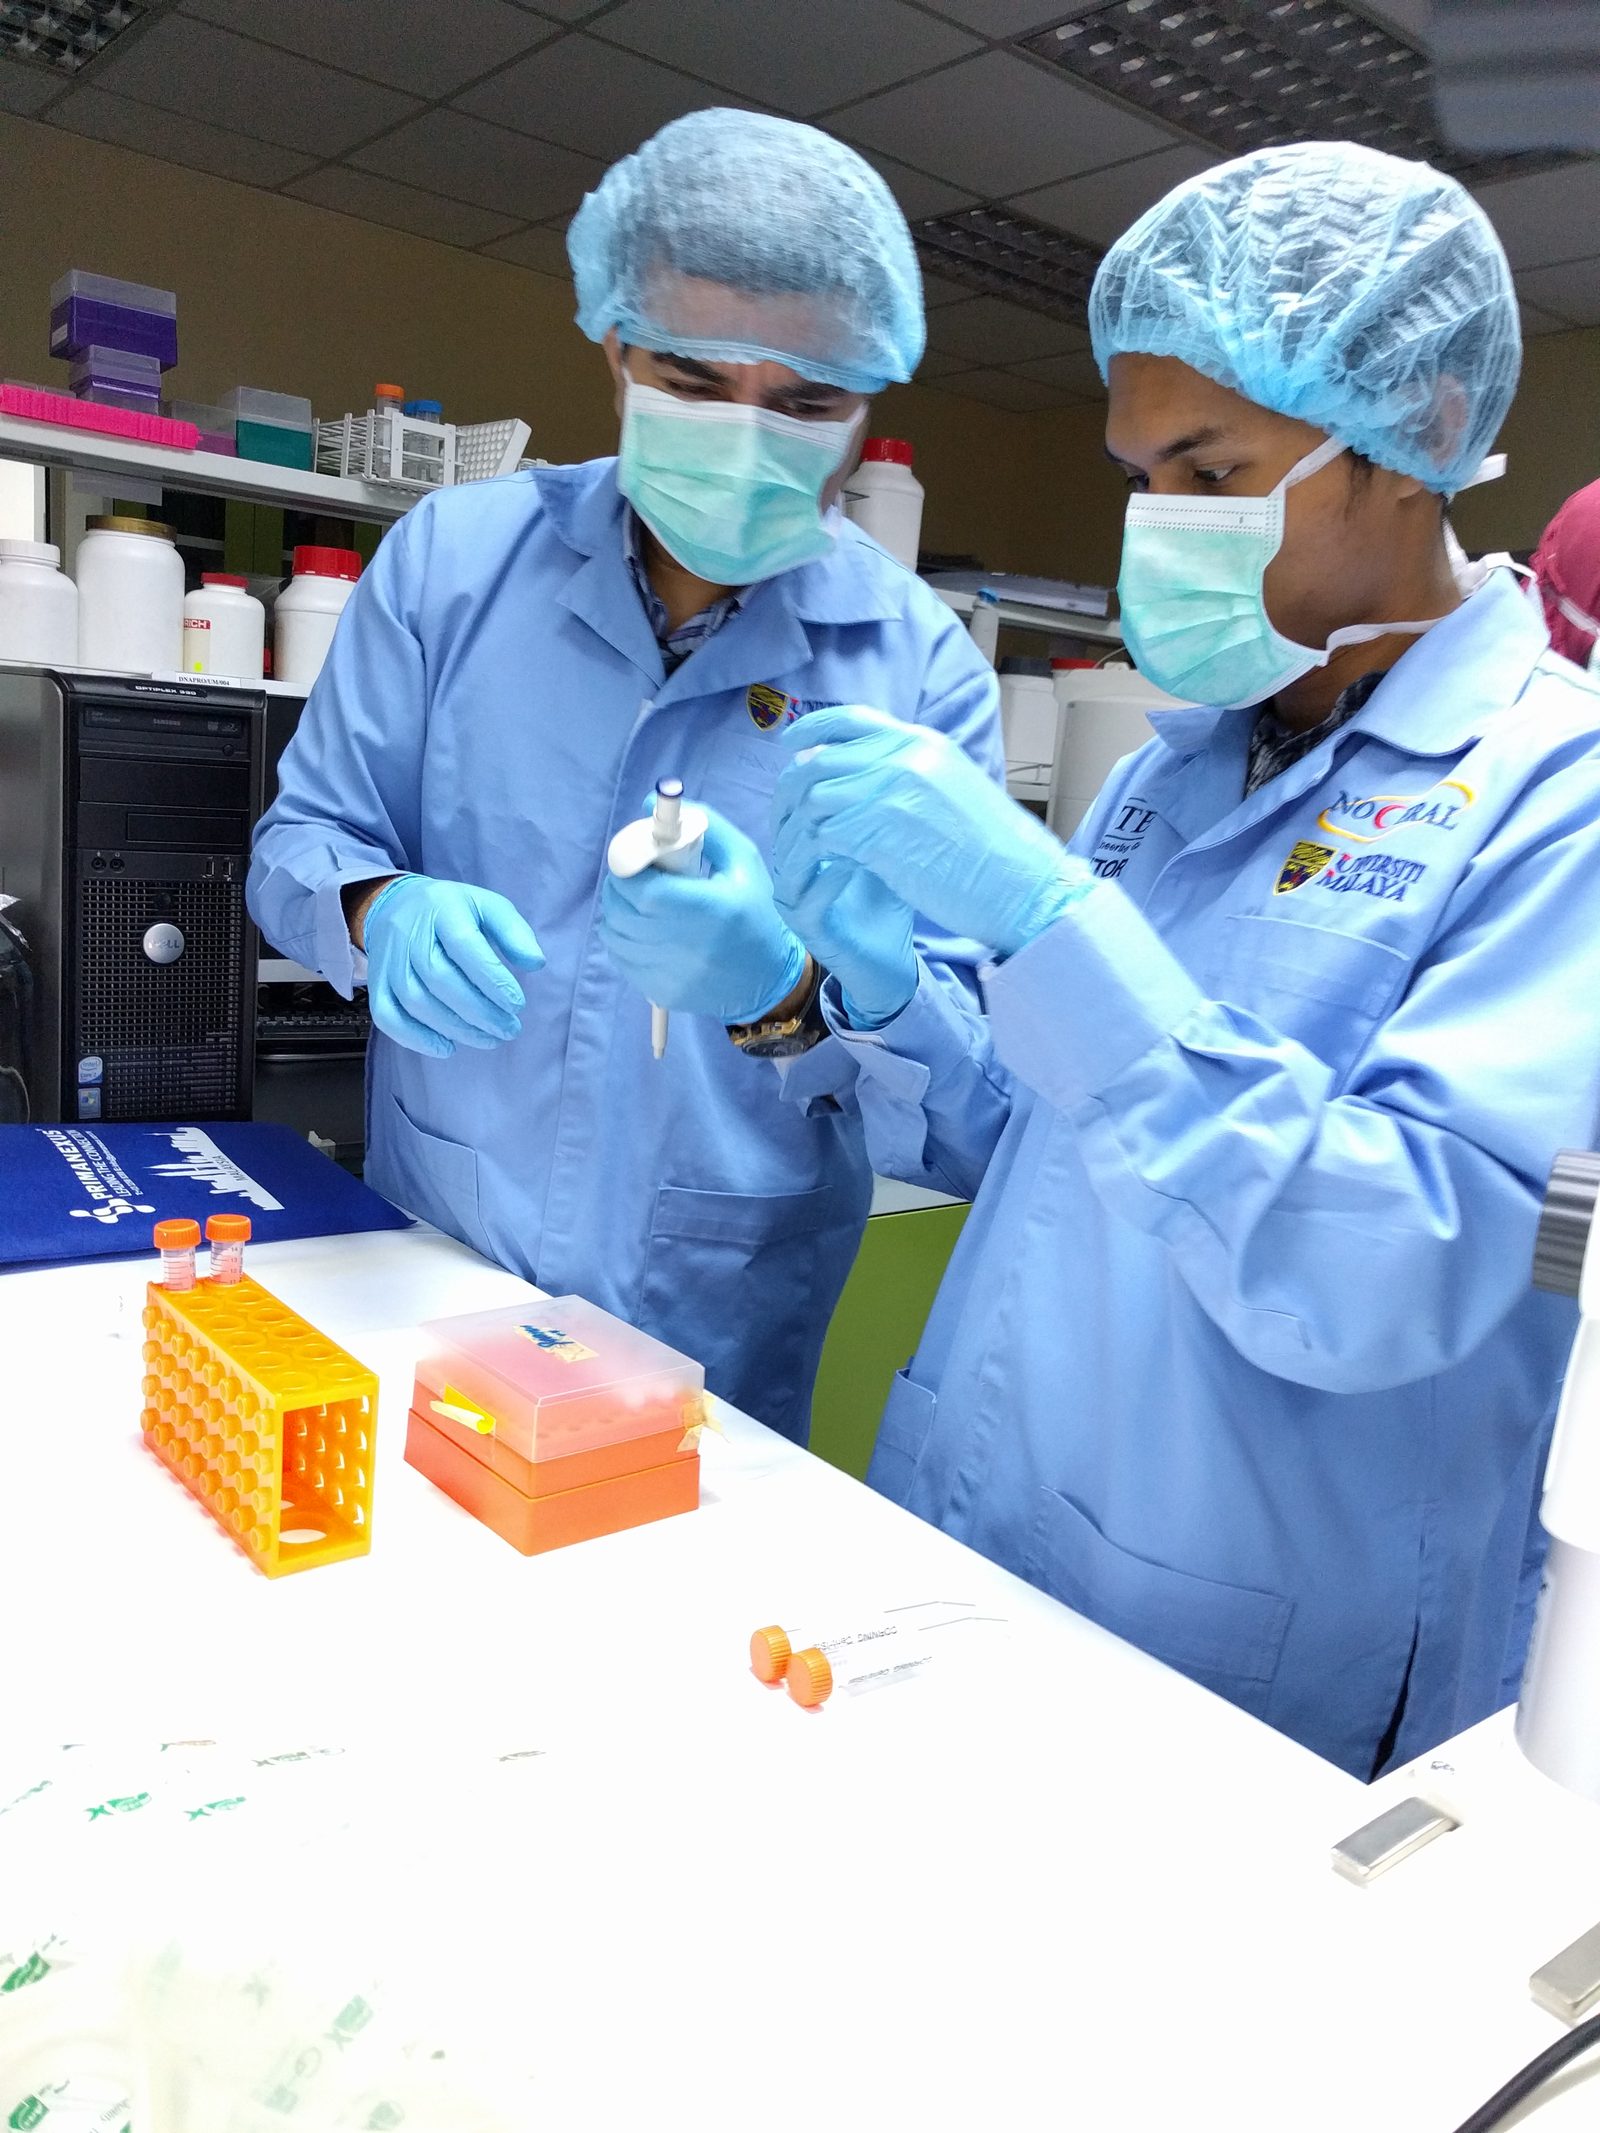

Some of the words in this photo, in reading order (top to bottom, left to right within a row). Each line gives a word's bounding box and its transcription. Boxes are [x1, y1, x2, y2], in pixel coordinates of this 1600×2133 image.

[135, 684, 177, 694] OPTIPLEX
[1315, 869, 1408, 902] MALAYA
[43, 1129, 114, 1201] PRIMANEXUS
